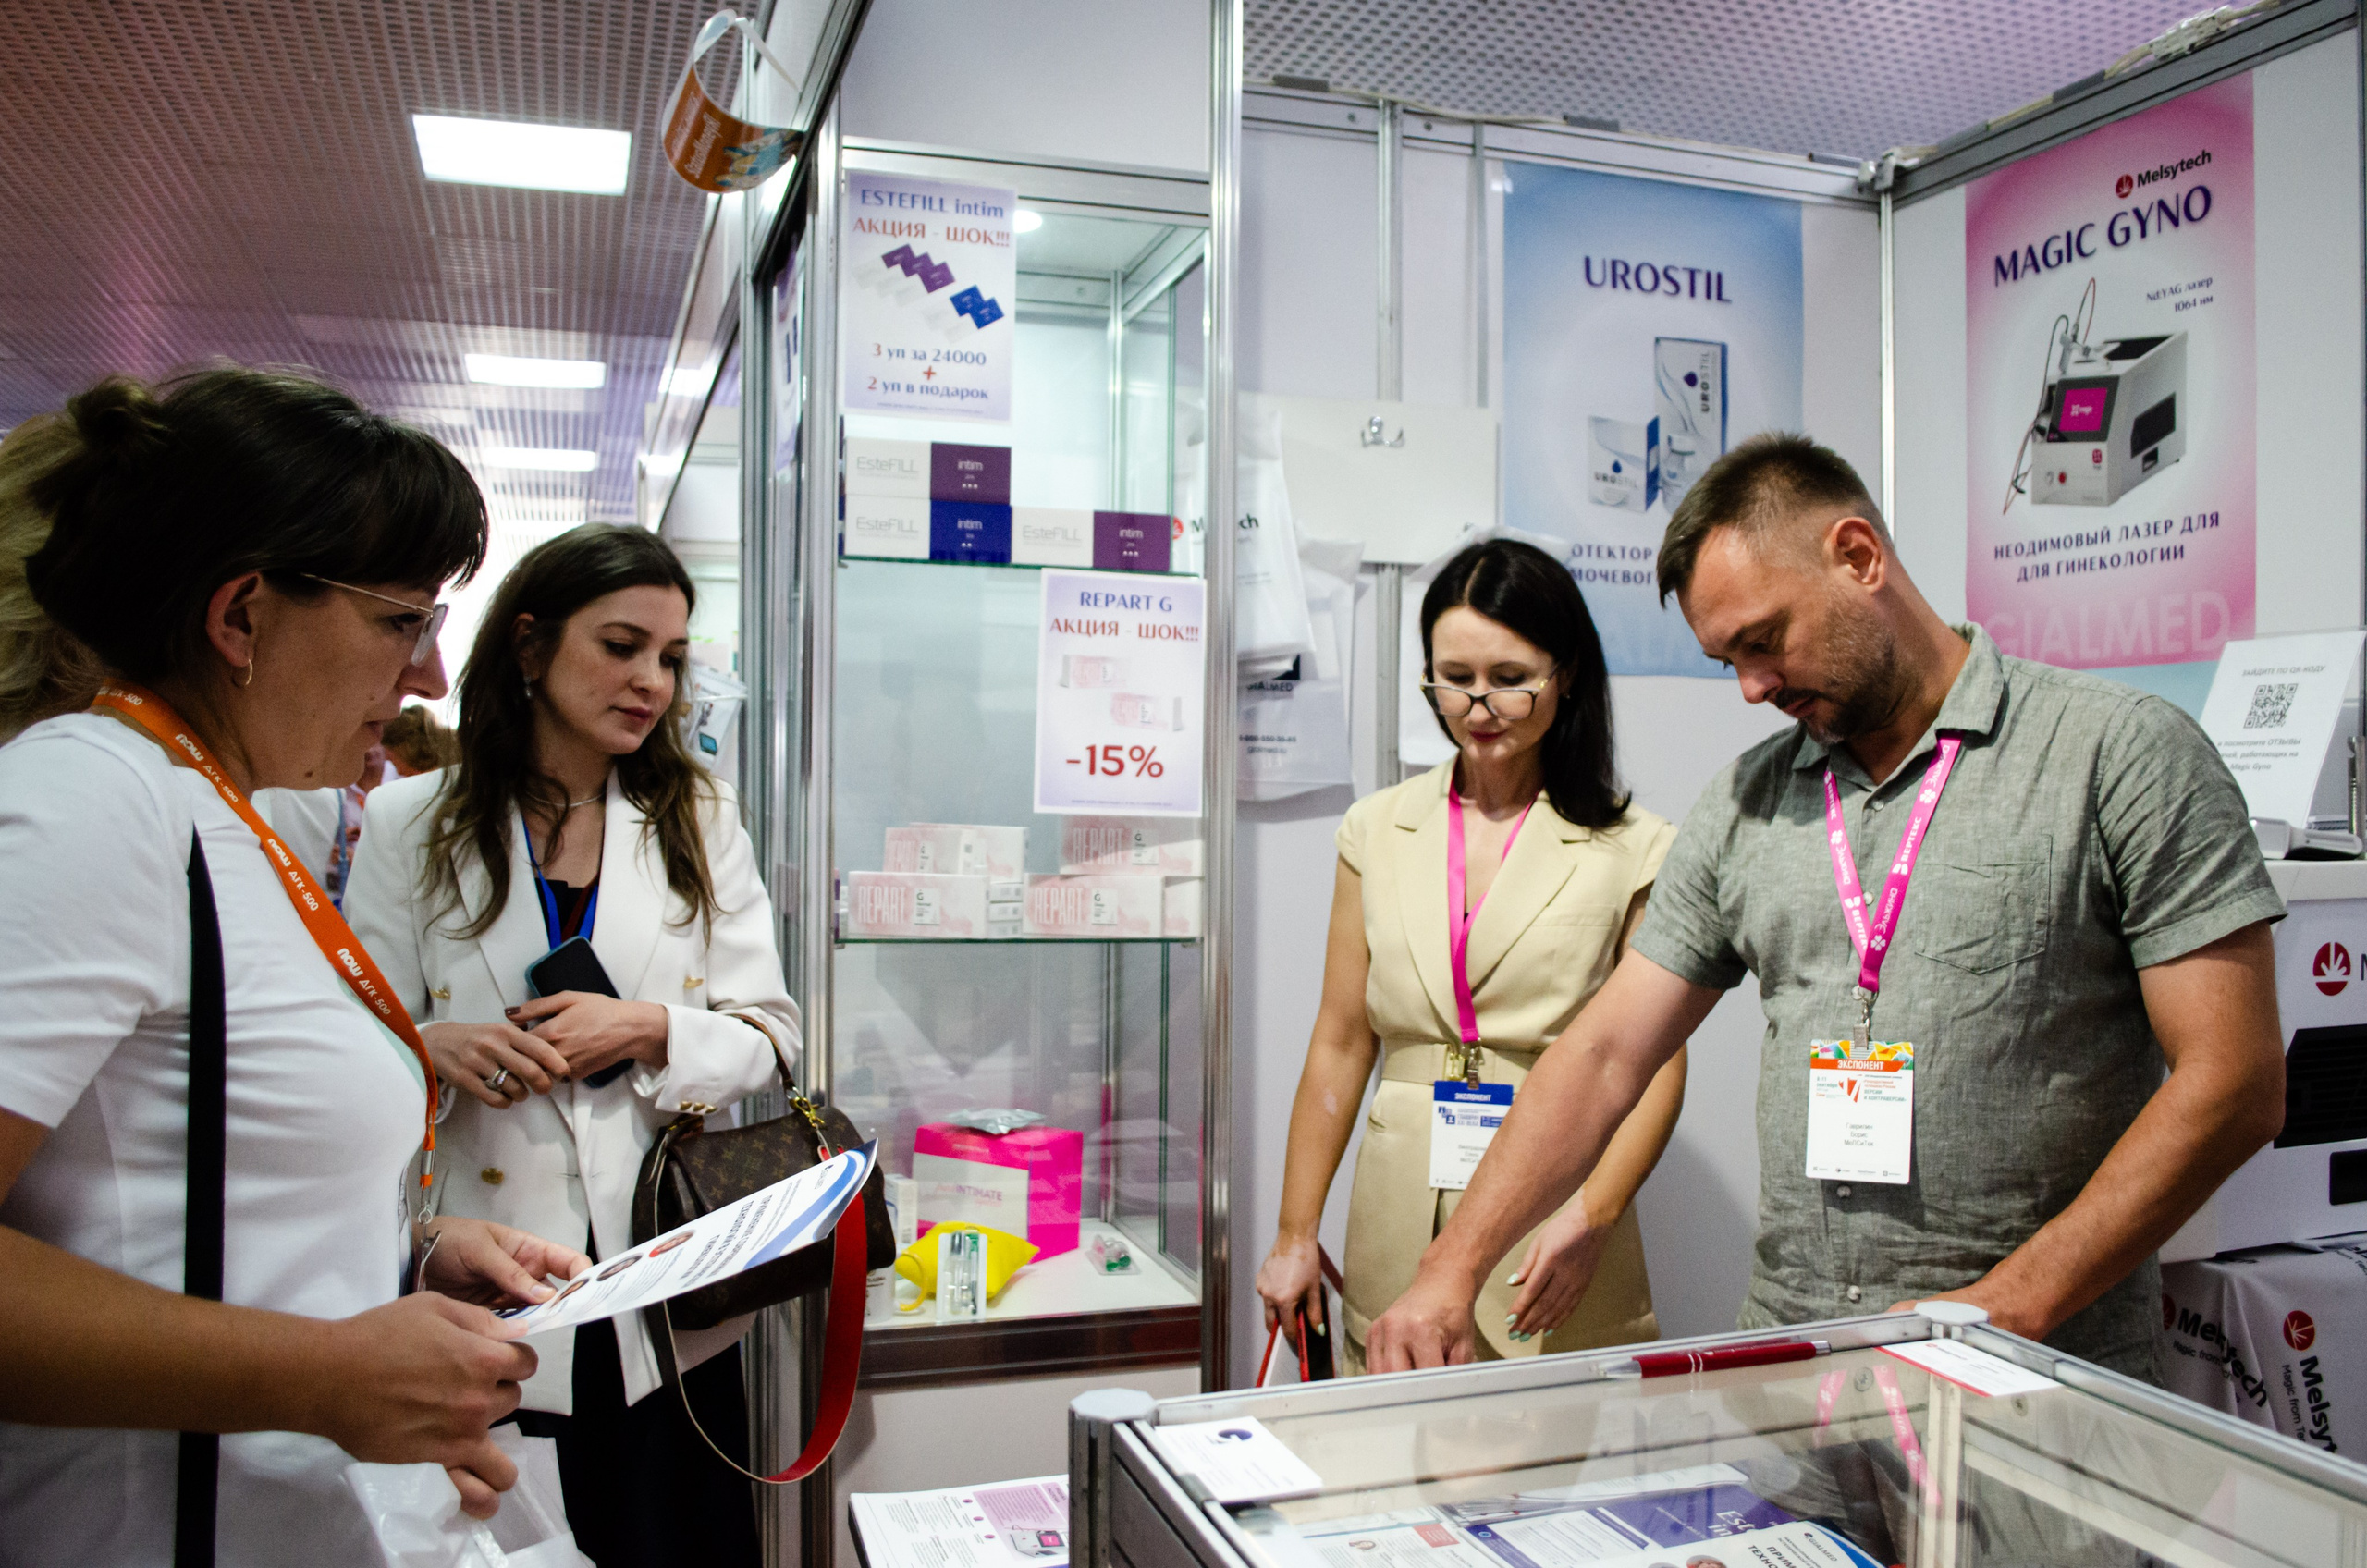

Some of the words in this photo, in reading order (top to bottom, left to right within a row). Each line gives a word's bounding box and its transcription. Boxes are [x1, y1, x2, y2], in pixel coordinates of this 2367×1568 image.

[2137, 149, 2212, 188] Melsytech
[862, 188, 949, 213] ESTEFILL
[955, 198, 1004, 218] intim
[853, 217, 926, 239] АКЦИЯ
[946, 225, 1010, 248] ШОК!!!
[1994, 222, 2097, 288] MAGIC
[2107, 185, 2212, 248] GYNO
[1584, 255, 1732, 304] UROSTIL
[873, 342, 881, 357] 3
[887, 347, 905, 361] уп
[911, 349, 926, 361] за
[932, 349, 987, 366] 24000
[867, 376, 877, 391] 2
[882, 380, 901, 394] уп
[905, 384, 915, 394] в
[919, 383, 989, 401] подарок
[1572, 543, 1653, 561] ОТЕКТОР
[1994, 526, 2111, 560] НЕОДИМОВЫЙ
[2118, 519, 2174, 542] ЛАЗЕР
[2180, 511, 2220, 535] ДЛЯ
[1571, 568, 1654, 585] МОЧЕВОГ
[2017, 562, 2051, 583] ДЛЯ
[2056, 544, 2185, 576] ГИНЕКОЛОГИИ
[1079, 591, 1154, 611] REPART
[1159, 596, 1173, 612] G
[1049, 618, 1119, 638] АКЦИЯ
[1137, 621, 1199, 642] ШОК!!!
[1988, 591, 2231, 662] GIALMED
[1066, 743, 1164, 778] -15%
[1901, 816, 1922, 863] ВЕРТЕКС
[1837, 1060, 1884, 1071] ЭКСПОНЕНТ
[2282, 1364, 2295, 1396] Magic
[2289, 1398, 2301, 1424] from
[2300, 1355, 2338, 1453] Melsyt
